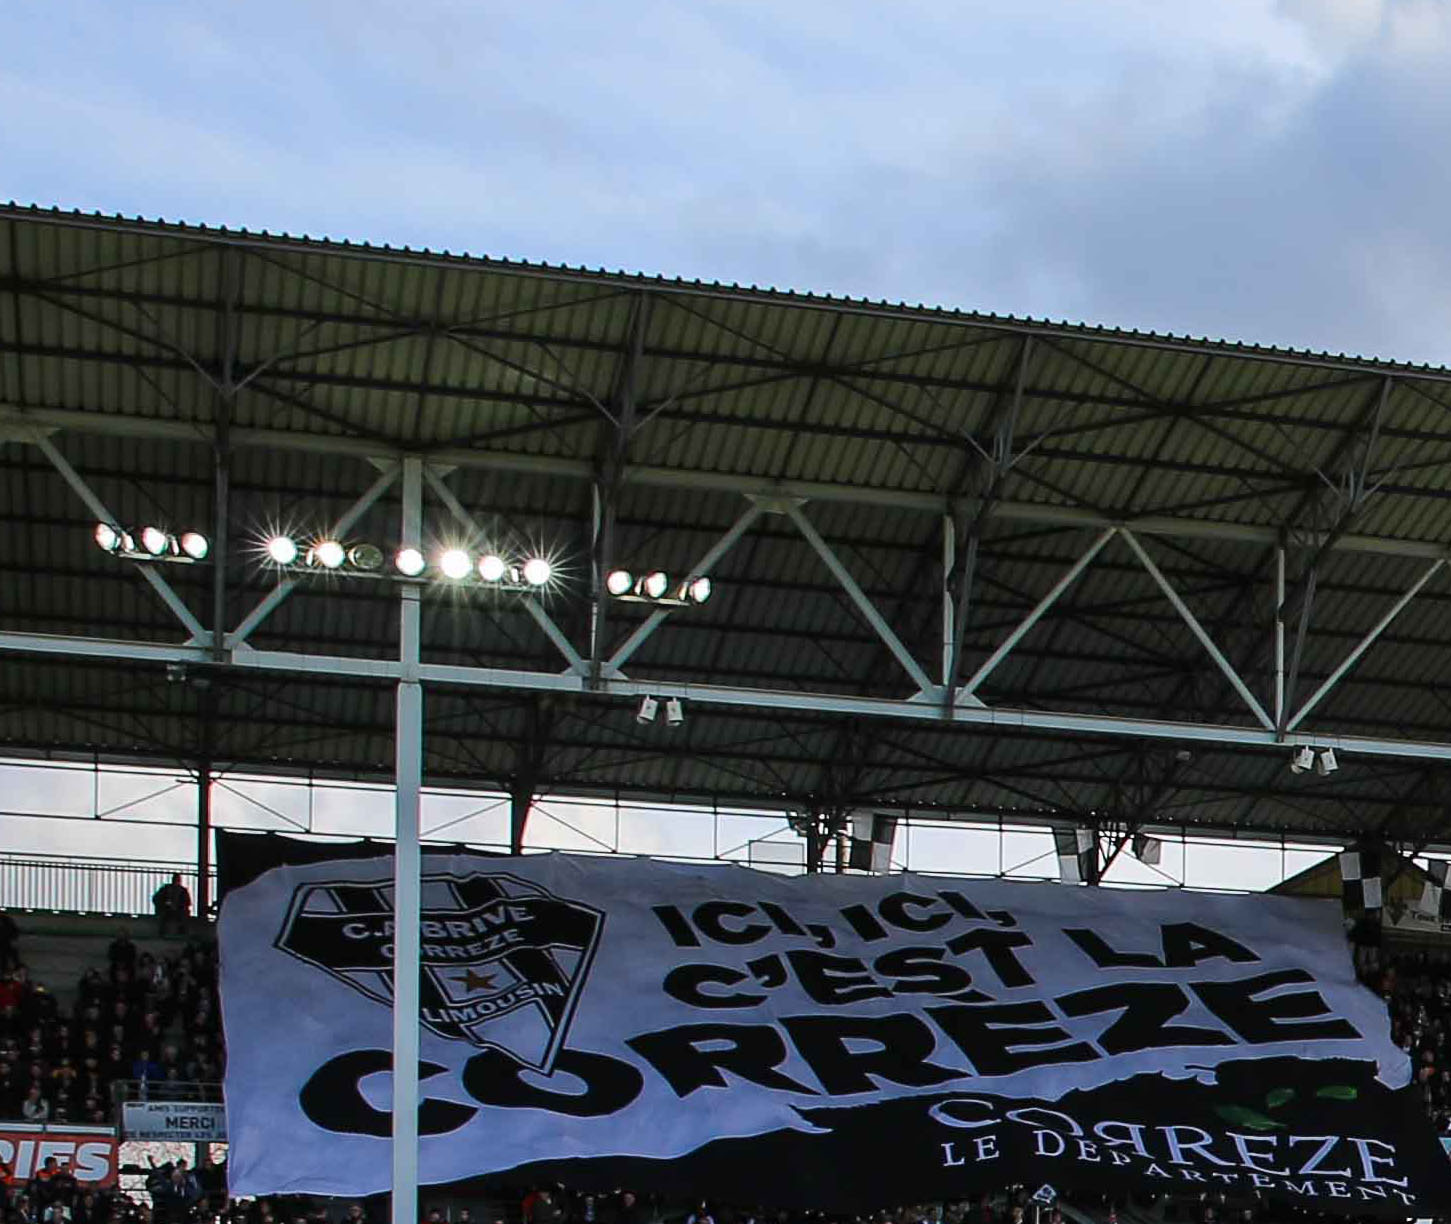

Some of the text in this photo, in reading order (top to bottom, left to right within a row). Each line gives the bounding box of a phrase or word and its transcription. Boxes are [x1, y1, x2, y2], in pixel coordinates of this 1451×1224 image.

[422, 907, 535, 939] BRIVE
[651, 891, 1018, 949] ICI, ICI,
[381, 928, 525, 958] CRREZE
[1061, 921, 1262, 968] LA
[423, 983, 567, 1023] LIMOUSIN
[298, 968, 1365, 1137] CORREZE
[165, 1116, 215, 1131] MERCI
[940, 1134, 999, 1167] LE
